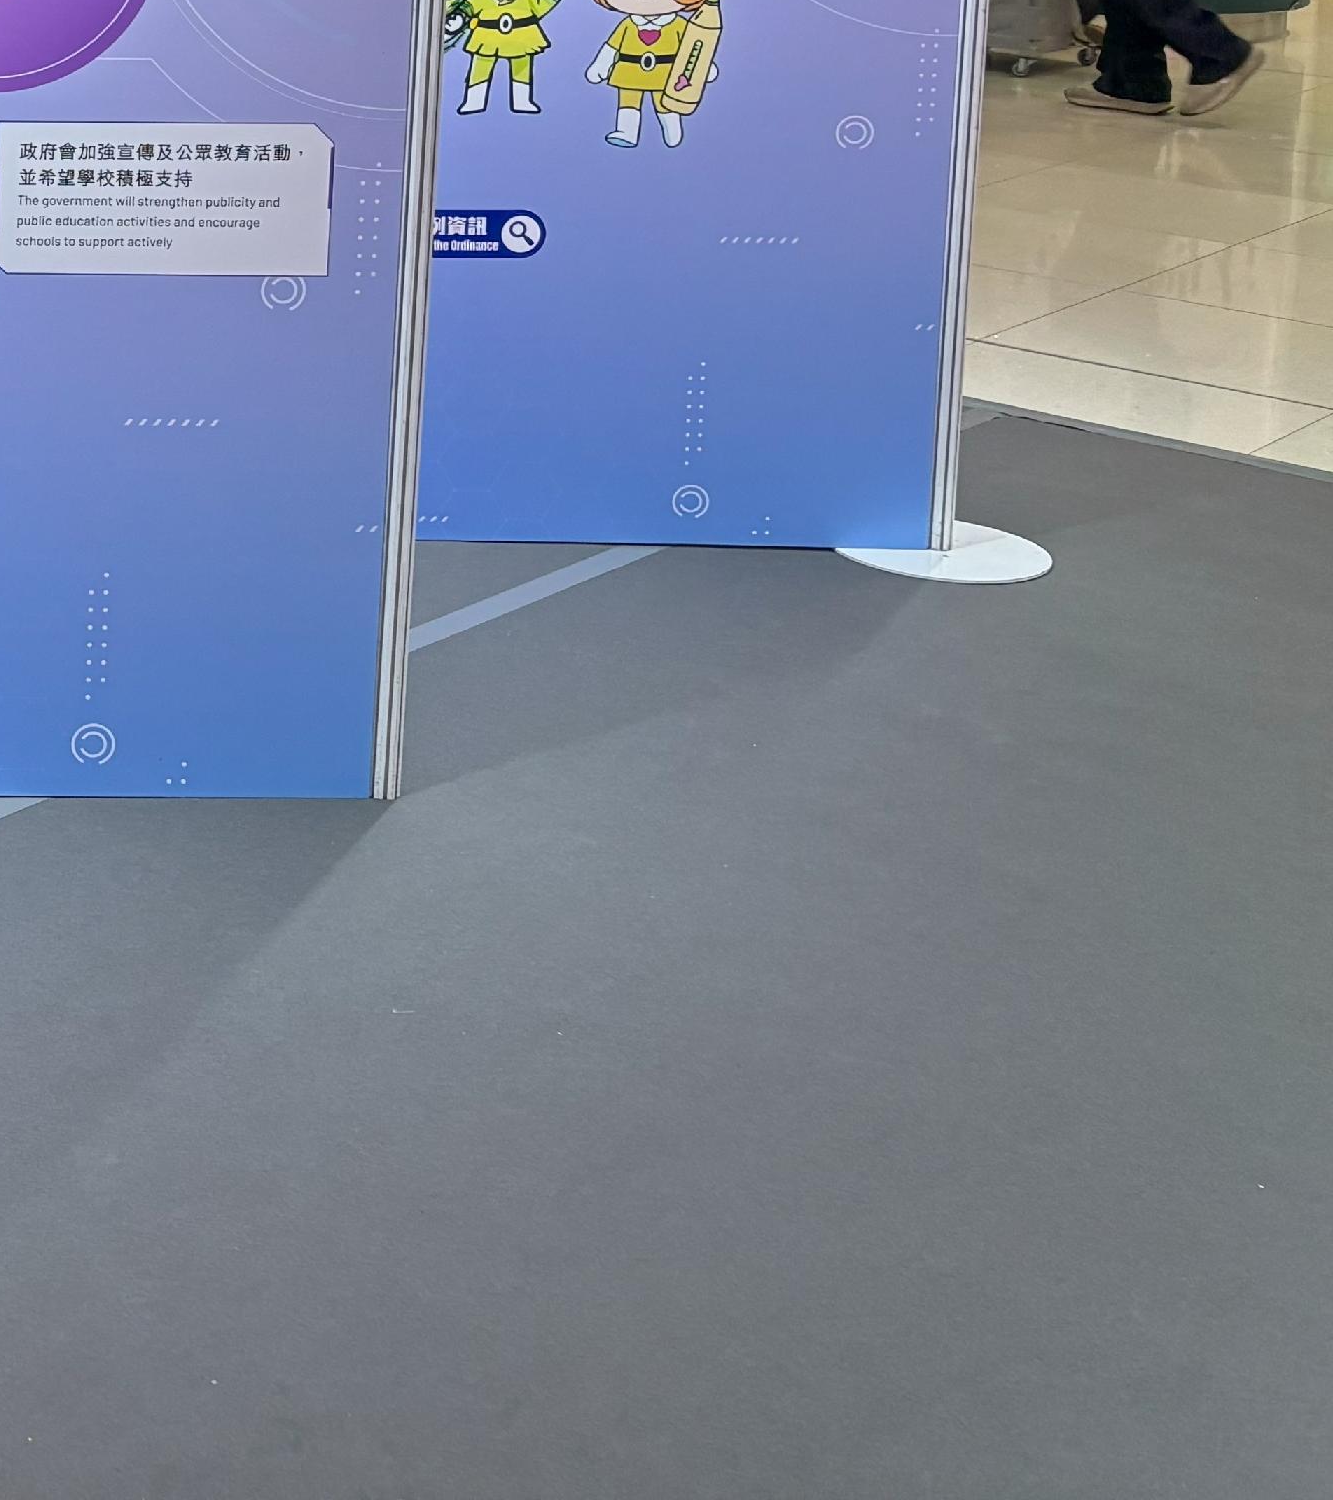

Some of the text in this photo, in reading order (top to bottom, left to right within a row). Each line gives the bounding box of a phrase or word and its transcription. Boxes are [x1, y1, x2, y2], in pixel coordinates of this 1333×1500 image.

[18, 169, 193, 188] 並希望學校積極支持
[18, 195, 281, 210] The government will strengthen publicity and
[16, 215, 260, 230] public education activities and encourage
[16, 235, 173, 250] schools to support actively
[434, 239, 499, 251] the Ordinance
